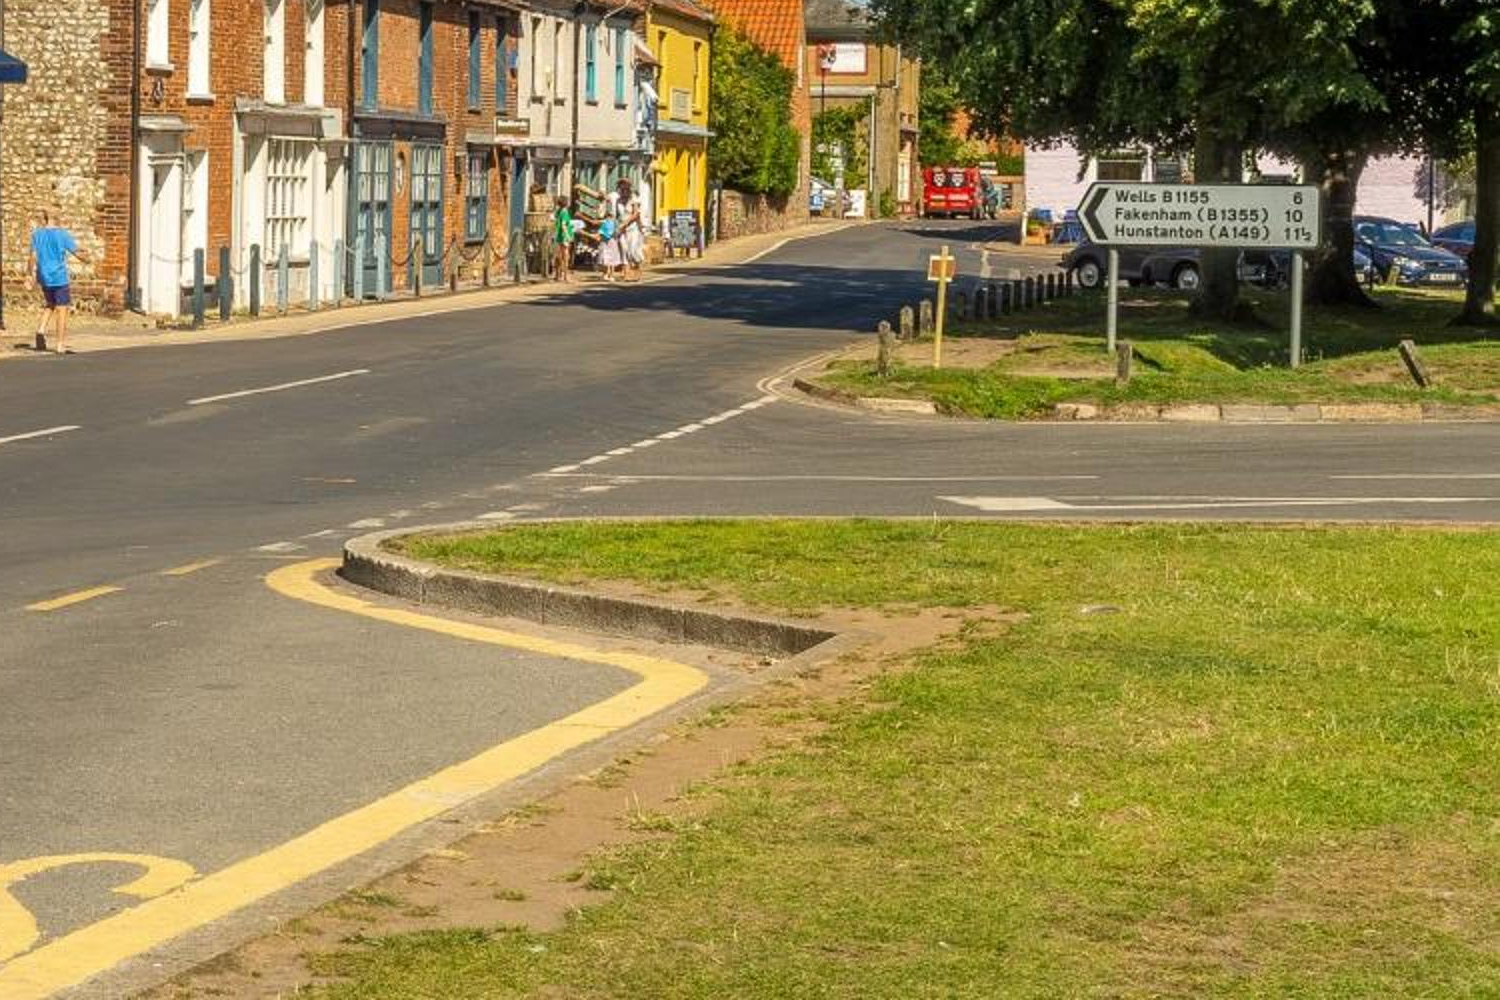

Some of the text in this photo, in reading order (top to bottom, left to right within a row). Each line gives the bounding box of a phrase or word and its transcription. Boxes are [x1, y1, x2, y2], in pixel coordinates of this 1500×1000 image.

[1115, 189, 1304, 205] Wells B1155 6
[1114, 207, 1303, 223] Fakenham (B1355) 10
[1114, 224, 1203, 239] Hunstanton
[1209, 225, 1270, 241] (A149)
